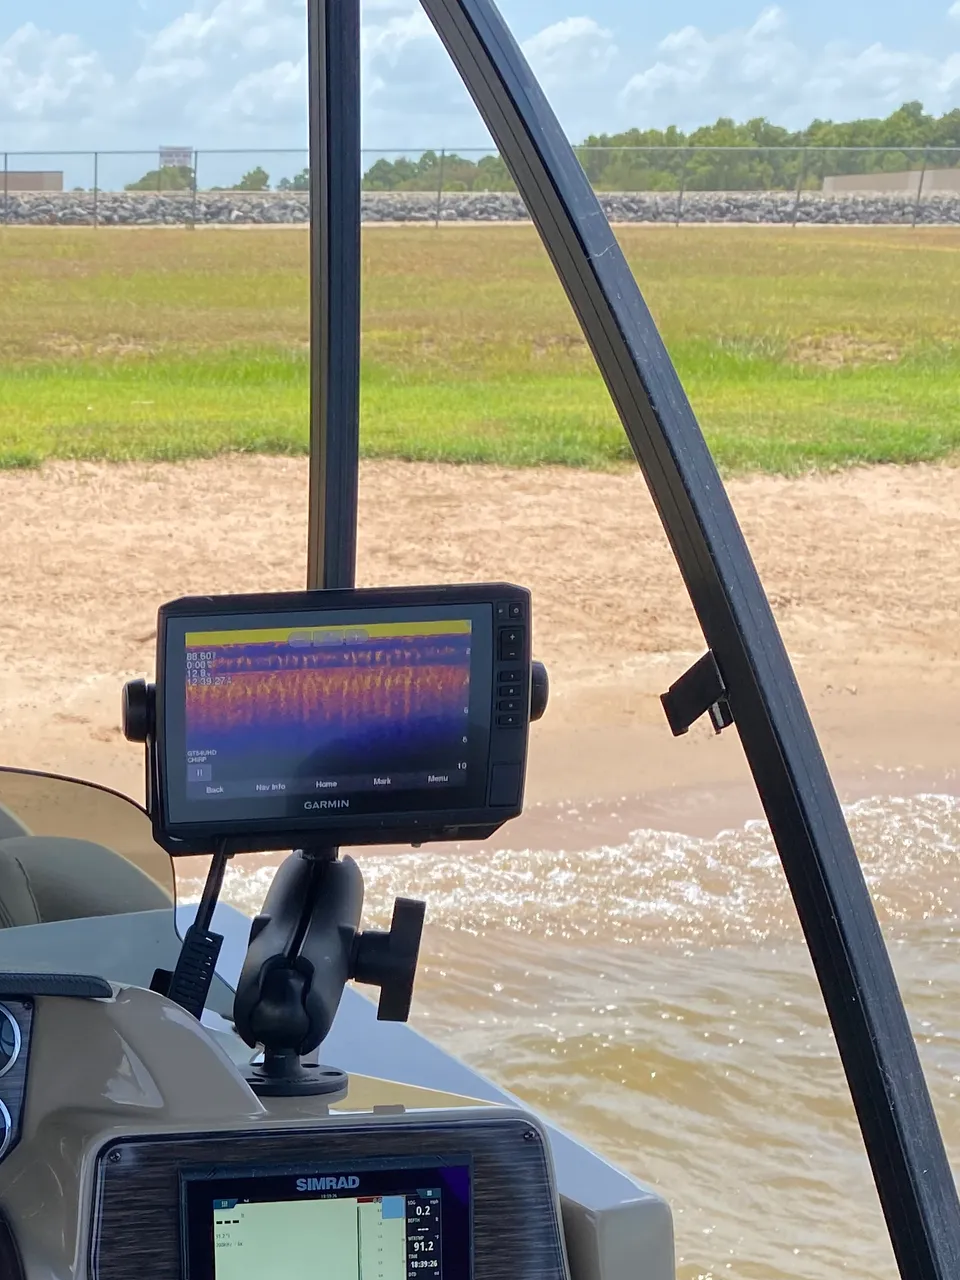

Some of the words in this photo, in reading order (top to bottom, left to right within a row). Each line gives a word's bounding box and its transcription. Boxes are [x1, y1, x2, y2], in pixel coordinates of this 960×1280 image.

[457, 762, 467, 770] 10
[373, 777, 391, 786] Mark
[427, 774, 449, 783] Menu
[256, 784, 269, 792] Nav
[271, 782, 286, 791] Info
[315, 780, 338, 789] Home
[206, 786, 224, 794] Back
[303, 799, 350, 810] GARMIN
[296, 1175, 360, 1191] SIMRAD
[415, 1205, 431, 1216] 0.2
[413, 1241, 434, 1252] 91.2
[410, 1259, 438, 1269] 18:39:26
